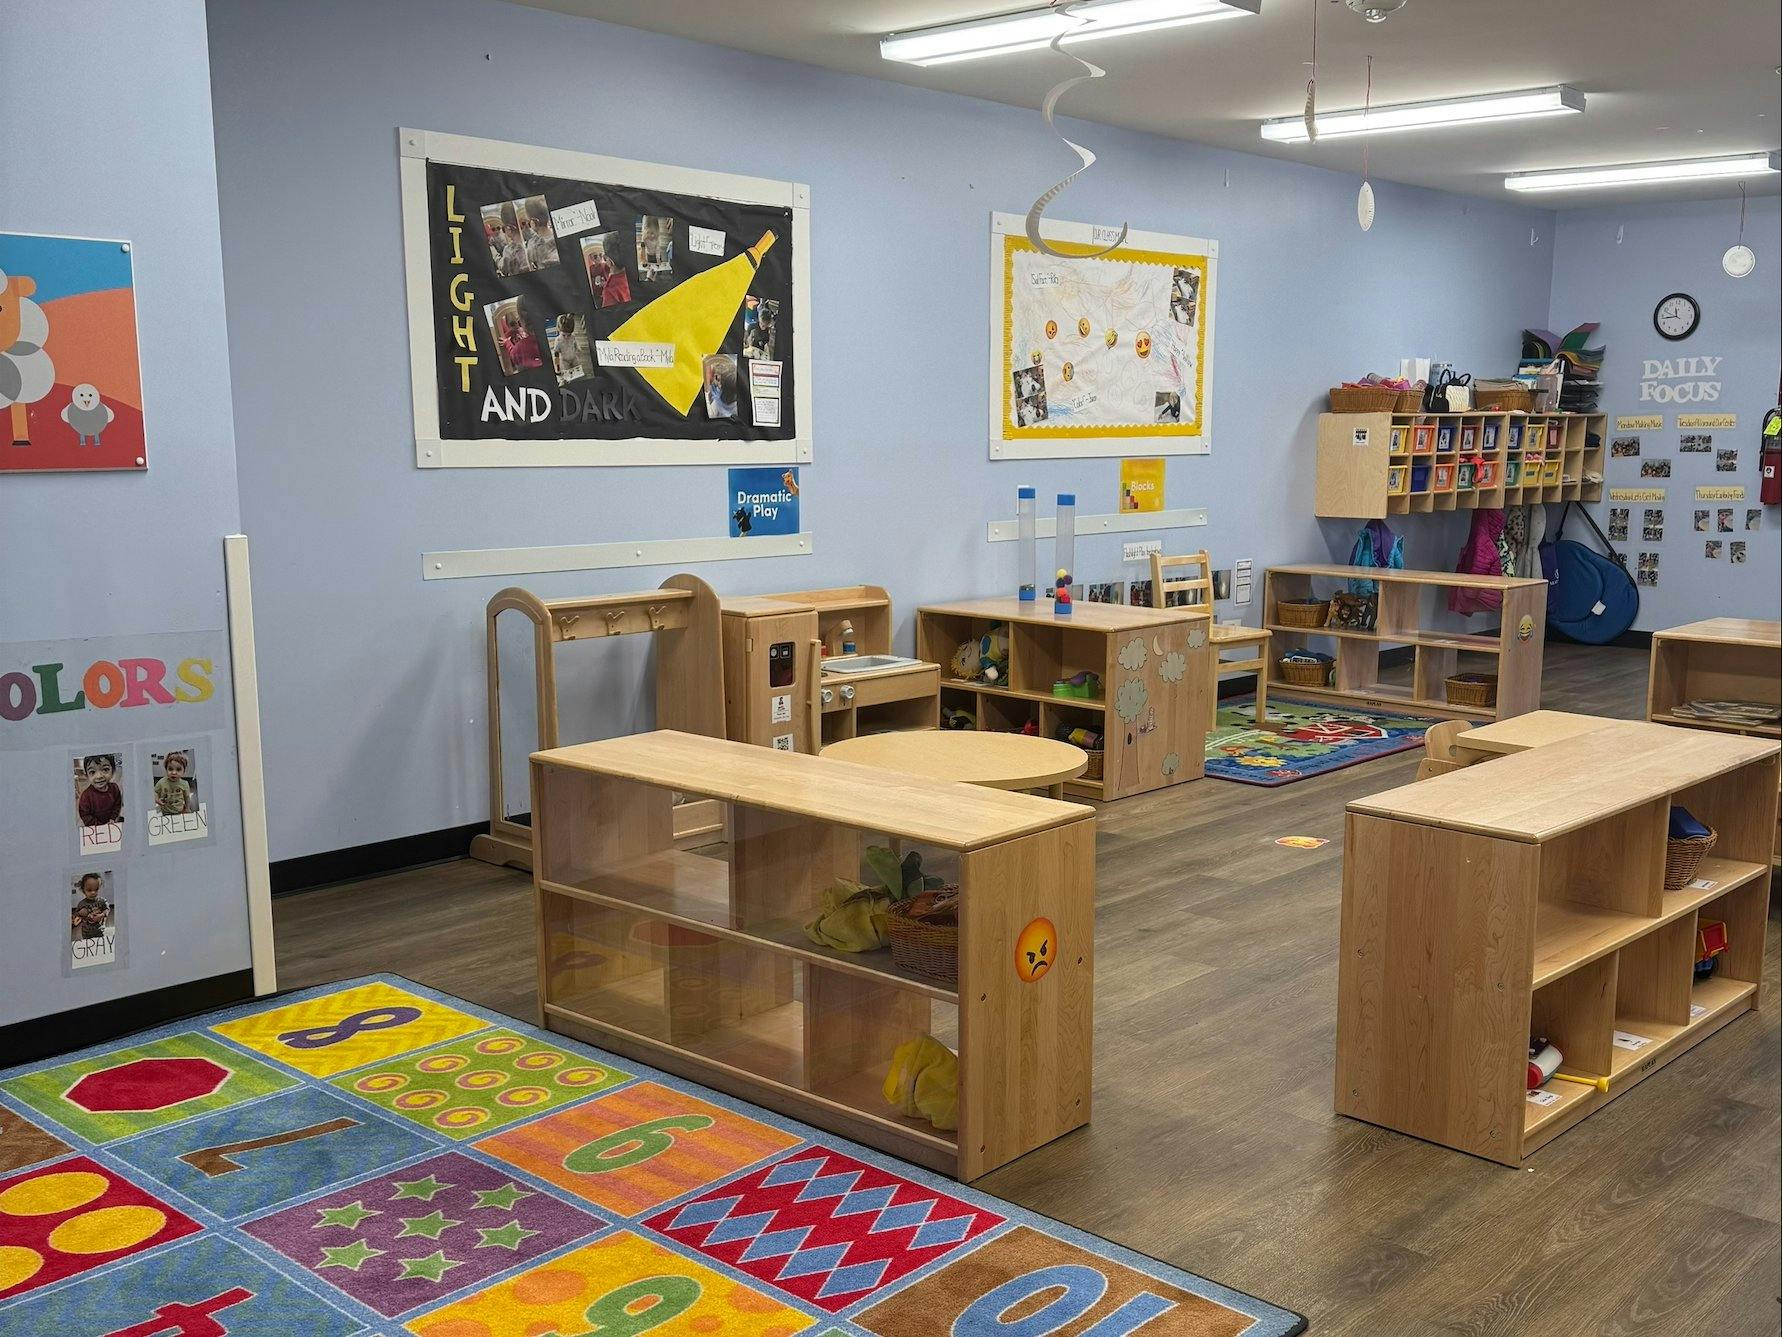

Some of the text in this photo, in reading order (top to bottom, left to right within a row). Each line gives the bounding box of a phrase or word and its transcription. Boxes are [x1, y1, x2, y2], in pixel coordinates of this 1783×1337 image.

[446, 185, 478, 393] LIGHT
[1642, 355, 1723, 379] DAILY
[480, 385, 644, 423] AND DARK
[1639, 381, 1721, 403] FOCUS
[737, 489, 792, 504] Dramatic
[1131, 480, 1155, 491] Blocks
[753, 504, 778, 520] Play
[82, 809, 207, 846] RED GREEN
[72, 934, 115, 959] GRAY
[275, 1006, 424, 1050] 8
